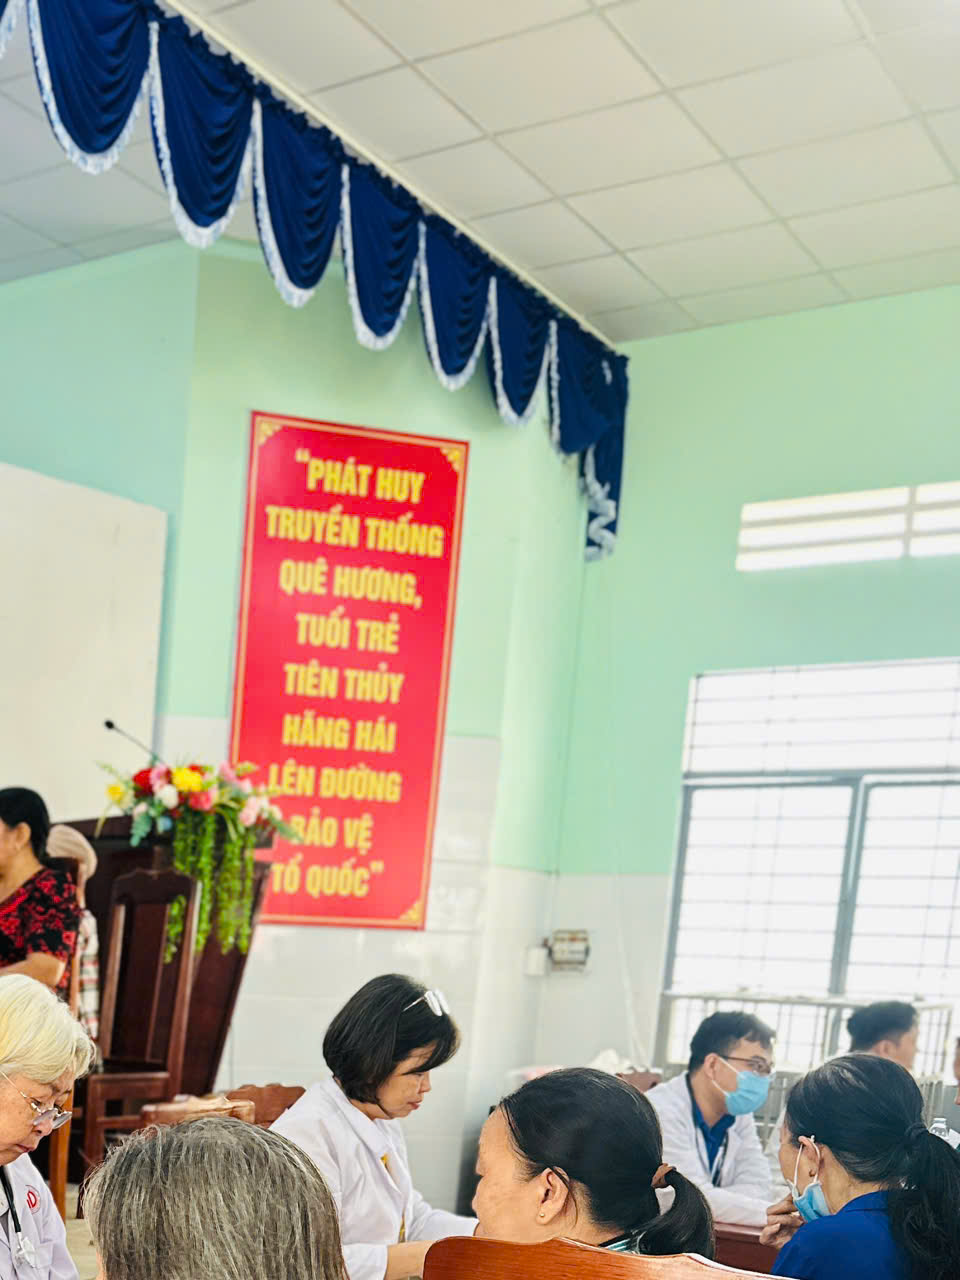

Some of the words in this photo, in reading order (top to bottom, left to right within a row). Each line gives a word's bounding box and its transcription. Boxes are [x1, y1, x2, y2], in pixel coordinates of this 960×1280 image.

[376, 467, 426, 504] HUY
[365, 511, 445, 558] THỐNG
[279, 556, 329, 596] QUÊ
[333, 564, 423, 610] HƯƠNG,
[355, 611, 401, 654] TRẺ
[283, 658, 339, 699] TIÊN
[344, 661, 405, 704] THỦY
[282, 708, 350, 750] HĂNG
[354, 715, 397, 754] HÁI
[268, 758, 316, 797] LÊN
[344, 812, 374, 855] VỆ
